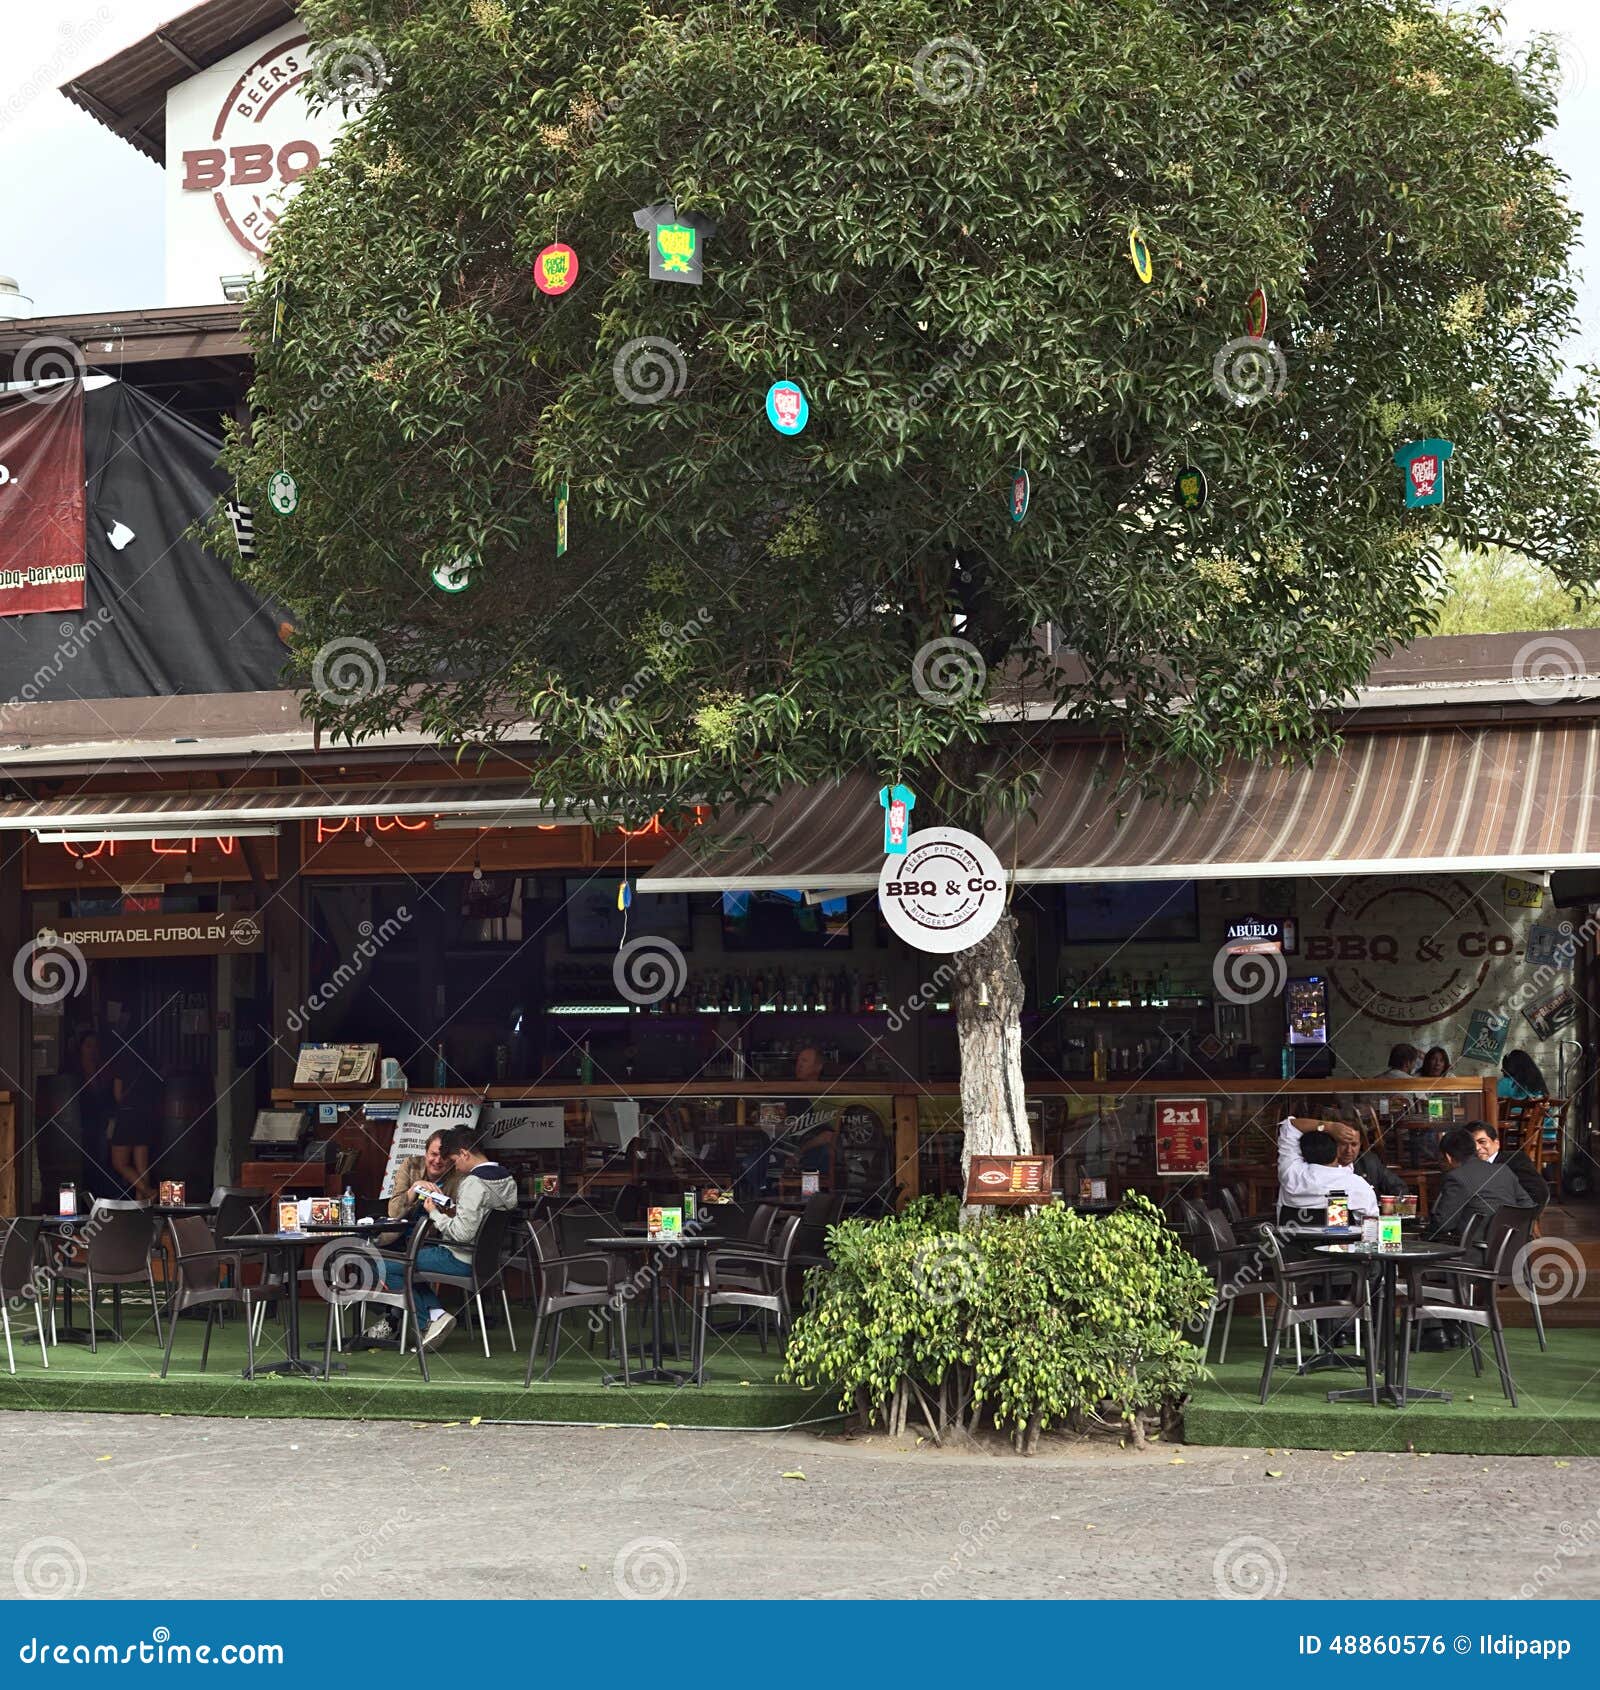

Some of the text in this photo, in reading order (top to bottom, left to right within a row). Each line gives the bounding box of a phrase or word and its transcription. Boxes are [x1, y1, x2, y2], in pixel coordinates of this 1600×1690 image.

[237, 56, 299, 118] BEERS
[182, 140, 321, 190] BBQ
[905, 846, 976, 873] BEERS PITCHERS
[886, 877, 1002, 897] BBQ & Co.
[911, 902, 975, 926] BURGERS GRILL
[64, 929, 124, 945] DISFRUTA
[127, 929, 154, 942] DEL
[154, 927, 205, 941] FUTBOL
[207, 926, 226, 939] EN
[1227, 923, 1278, 938] ABUELO
[1304, 934, 1399, 964] BBQ
[1415, 936, 1446, 963] &
[1457, 931, 1524, 957] Co.
[1428, 983, 1467, 1014] GRILL
[408, 1103, 474, 1119] NECESITAS
[1163, 1108, 1200, 1123] 2x1
[489, 1116, 554, 1138] Miller TIME
[784, 1110, 838, 1137] Miller
[840, 1115, 870, 1124] TIME
